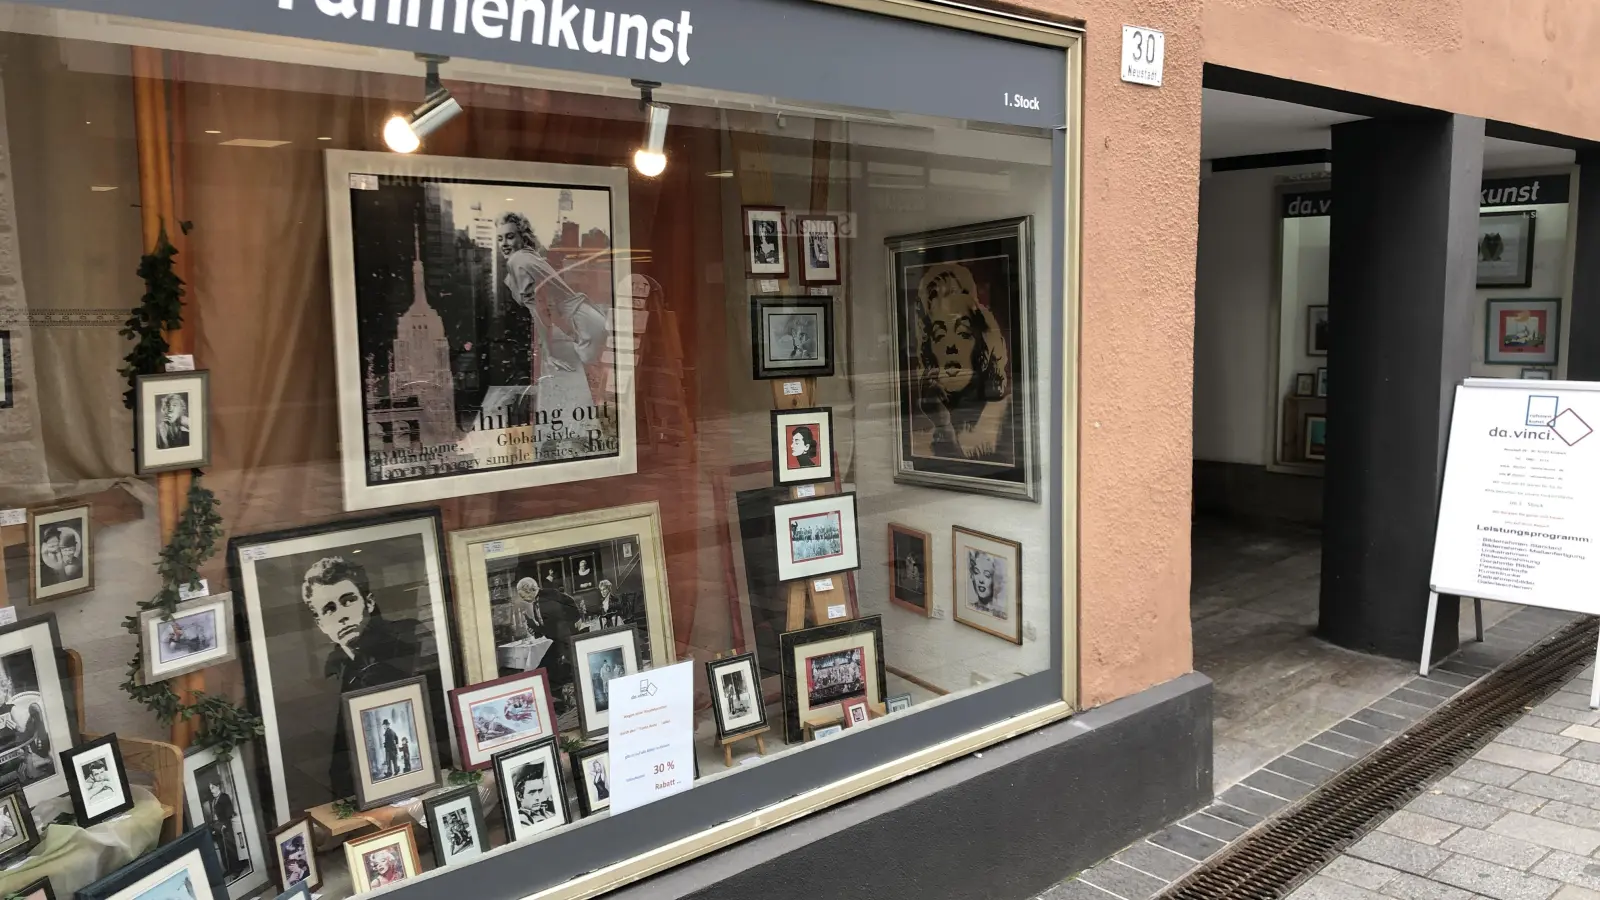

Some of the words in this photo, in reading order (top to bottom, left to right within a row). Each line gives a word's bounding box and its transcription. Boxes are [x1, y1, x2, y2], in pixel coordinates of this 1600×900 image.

[1132, 30, 1156, 64] 30
[1127, 64, 1158, 81] Neustadt
[1003, 92, 1013, 107] 1.
[1014, 94, 1040, 111] Stock
[572, 401, 610, 422] out
[497, 430, 542, 447] Global
[1488, 426, 1556, 441] da.vinci.
[486, 449, 530, 465] simple
[653, 763, 665, 775] 30
[666, 760, 675, 771] %
[655, 779, 676, 790] Rabatt
